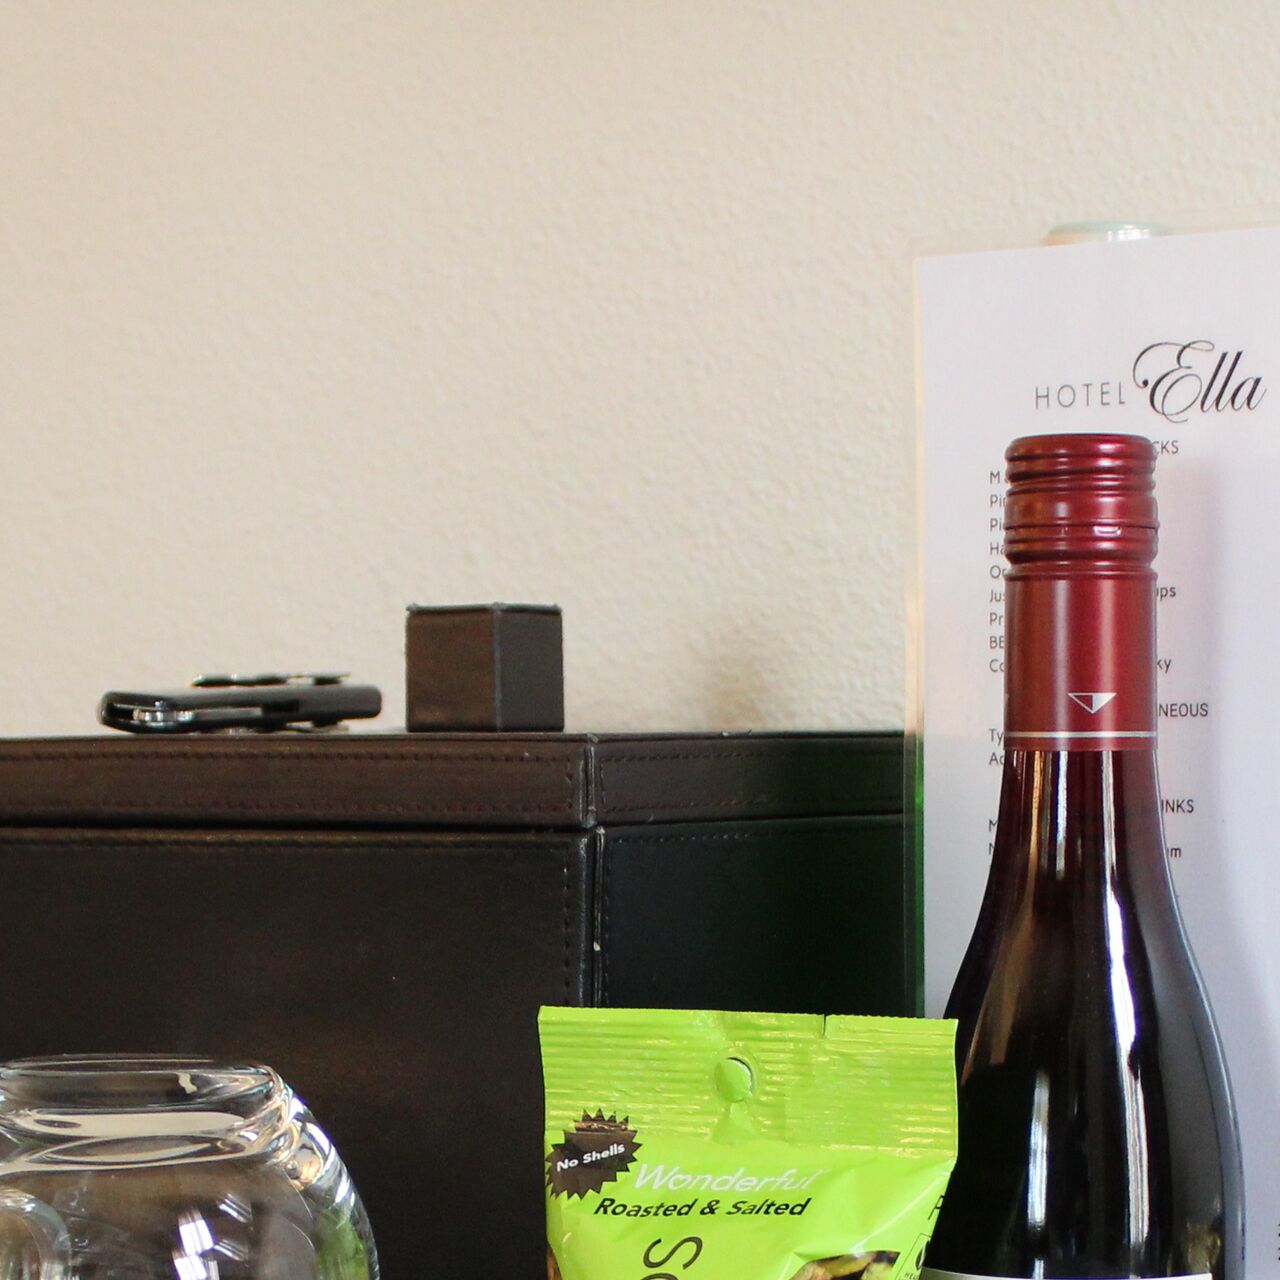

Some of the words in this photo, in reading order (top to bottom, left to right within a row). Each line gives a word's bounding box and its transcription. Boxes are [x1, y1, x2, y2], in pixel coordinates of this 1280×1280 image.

[1034, 381, 1126, 410] HOTEL
[1132, 339, 1267, 424] Ella
[1158, 703, 1209, 717] NEOUS
[1161, 798, 1195, 814] INKS
[556, 1158, 579, 1172] No
[582, 1143, 626, 1164] Shells
[634, 1163, 822, 1192] Wonderful
[593, 1196, 700, 1218] Roasted
[699, 1198, 721, 1216] &
[724, 1196, 813, 1217] Salted
